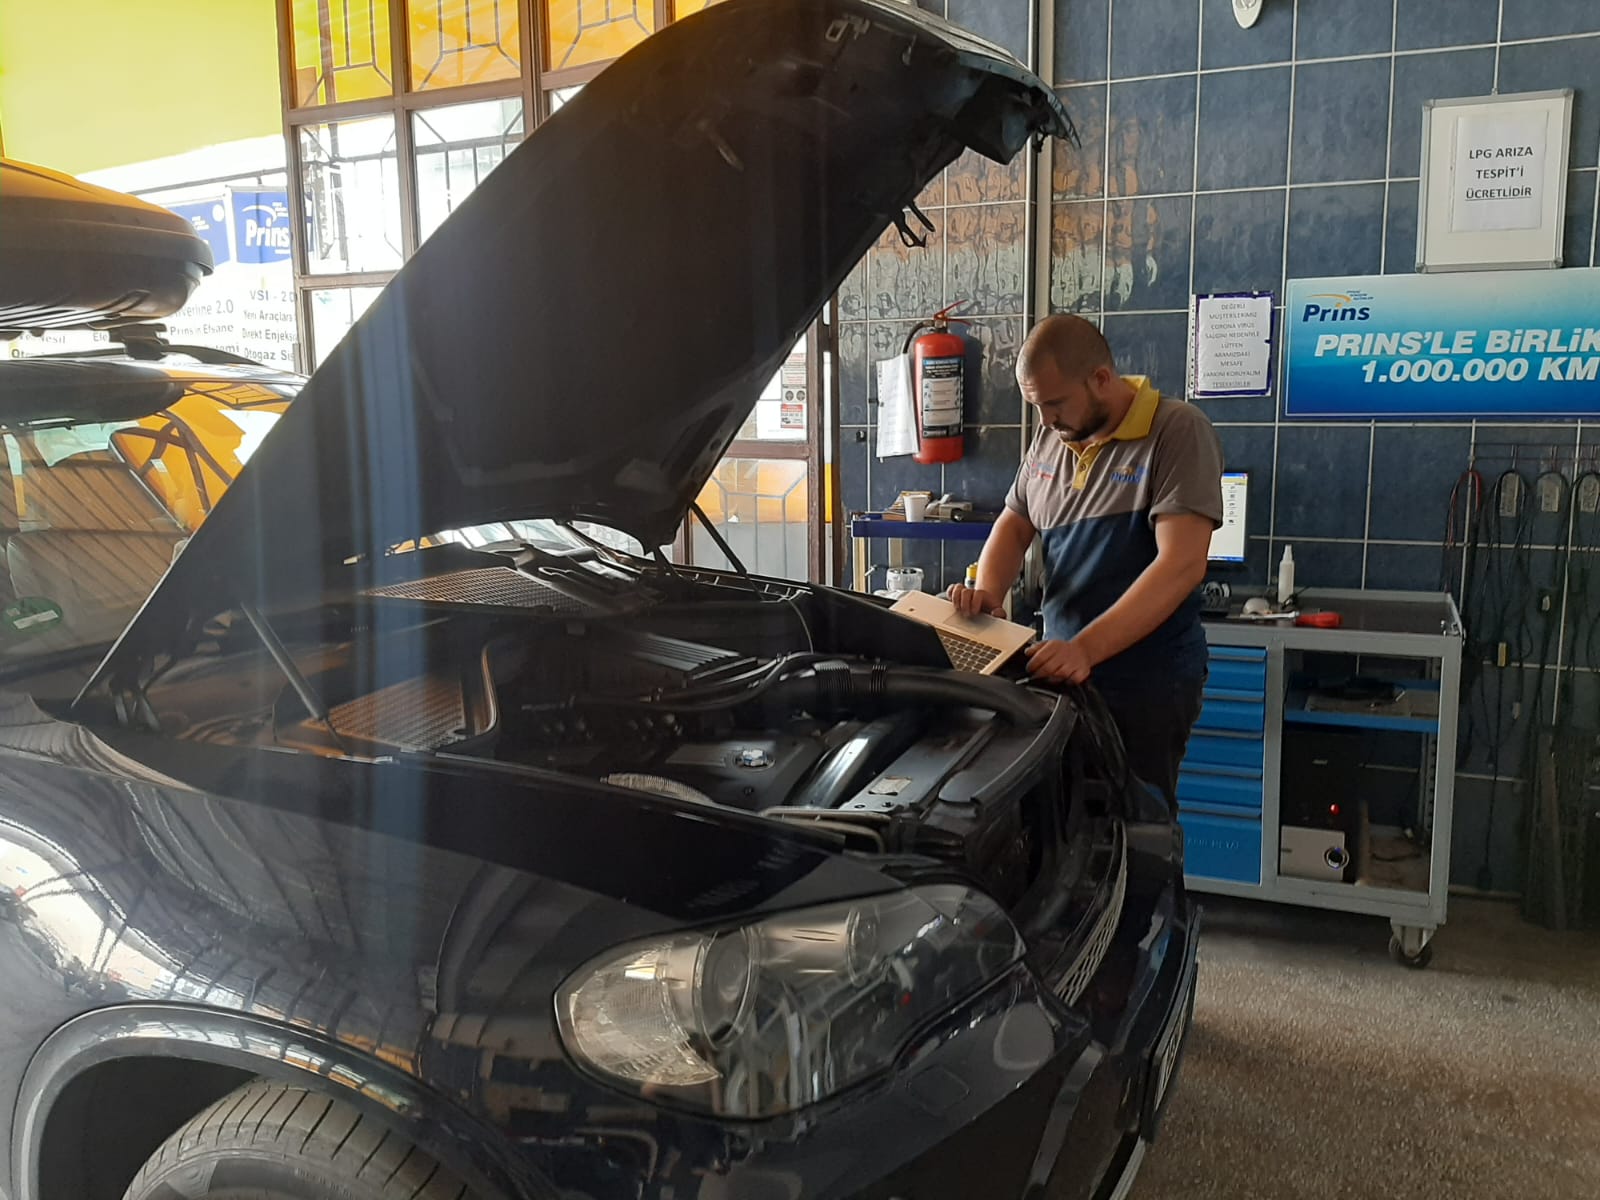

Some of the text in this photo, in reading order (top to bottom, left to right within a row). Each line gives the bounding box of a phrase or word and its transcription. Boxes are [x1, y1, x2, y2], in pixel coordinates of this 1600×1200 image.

[1469, 146, 1534, 159] LPG ARIZA
[1466, 187, 1532, 199] ÜCRETLİDİR
[245, 218, 290, 247] Prins
[250, 289, 269, 301] VSI
[216, 299, 234, 314] 2.0
[1302, 301, 1370, 322] Prins
[1361, 356, 1600, 383] 1.000.000 KM
